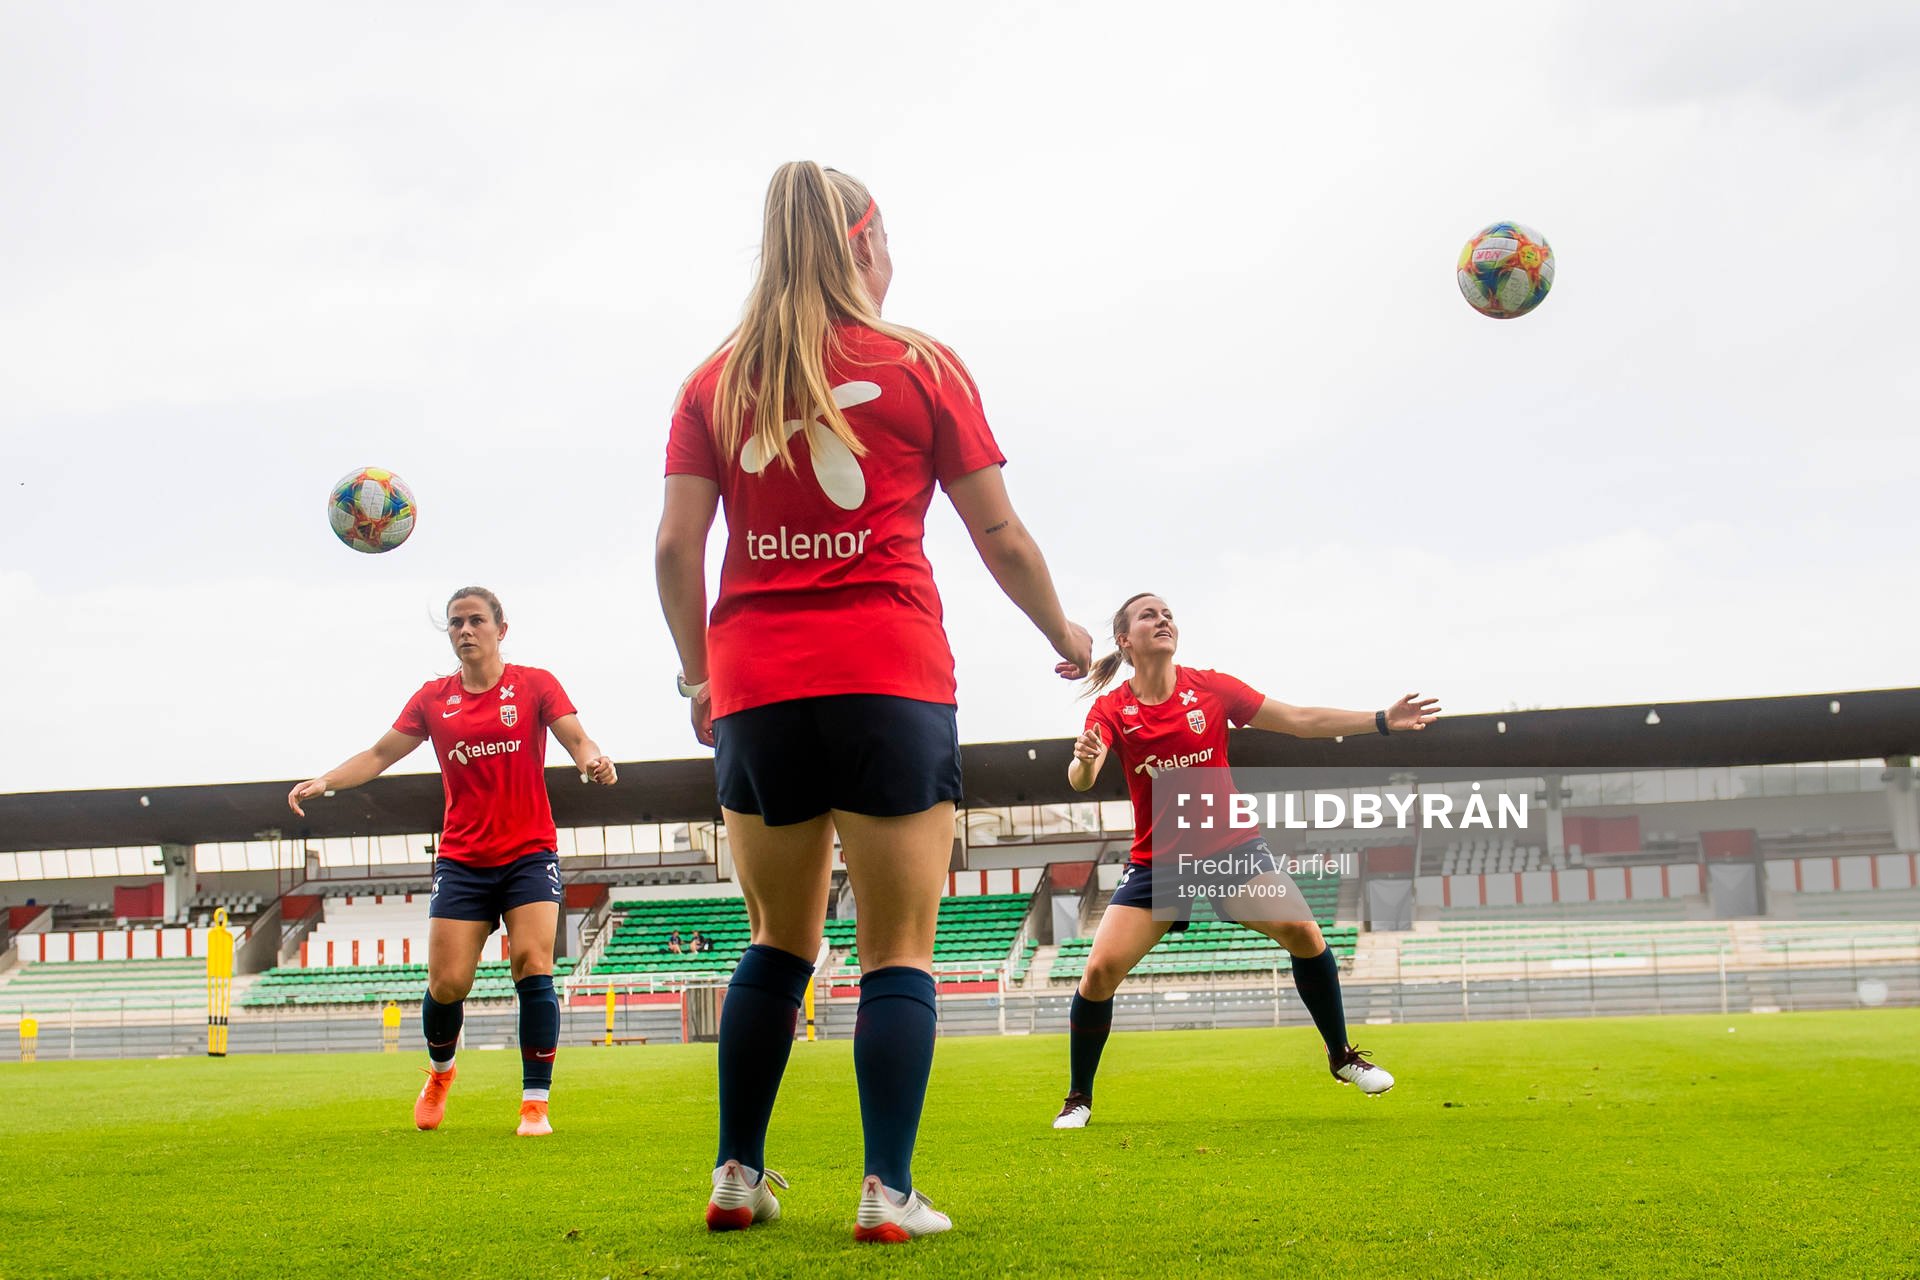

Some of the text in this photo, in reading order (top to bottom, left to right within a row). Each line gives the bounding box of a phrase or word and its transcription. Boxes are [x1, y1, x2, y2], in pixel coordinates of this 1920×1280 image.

[746, 526, 872, 560] telenor
[465, 740, 521, 758] telenor
[1157, 747, 1214, 772] telenor
